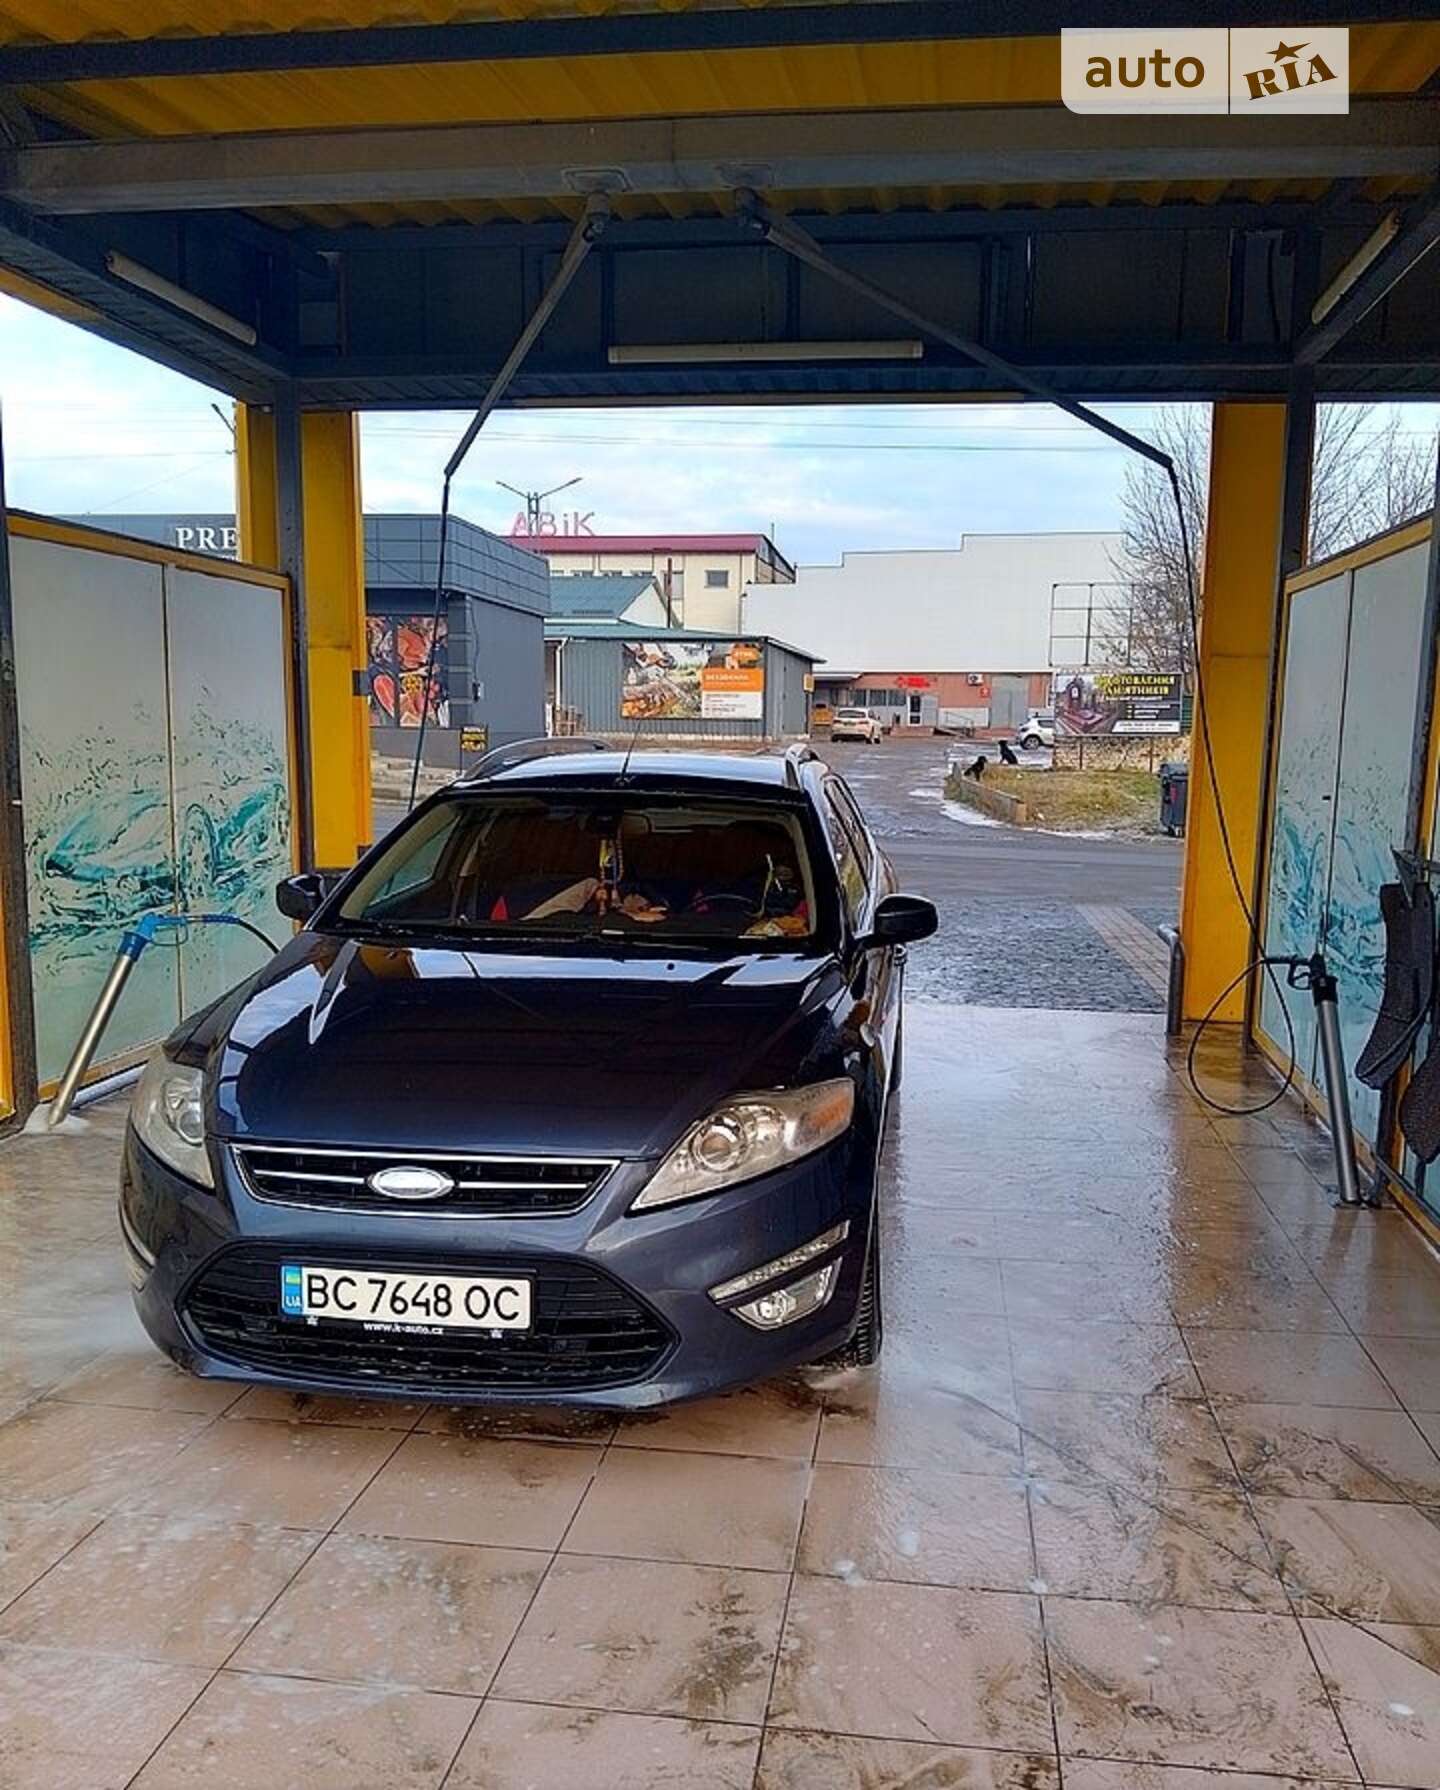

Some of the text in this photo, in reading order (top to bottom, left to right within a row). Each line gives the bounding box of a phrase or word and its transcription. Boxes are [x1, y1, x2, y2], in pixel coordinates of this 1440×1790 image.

[307, 1274, 520, 1321] BC 7648 OC
